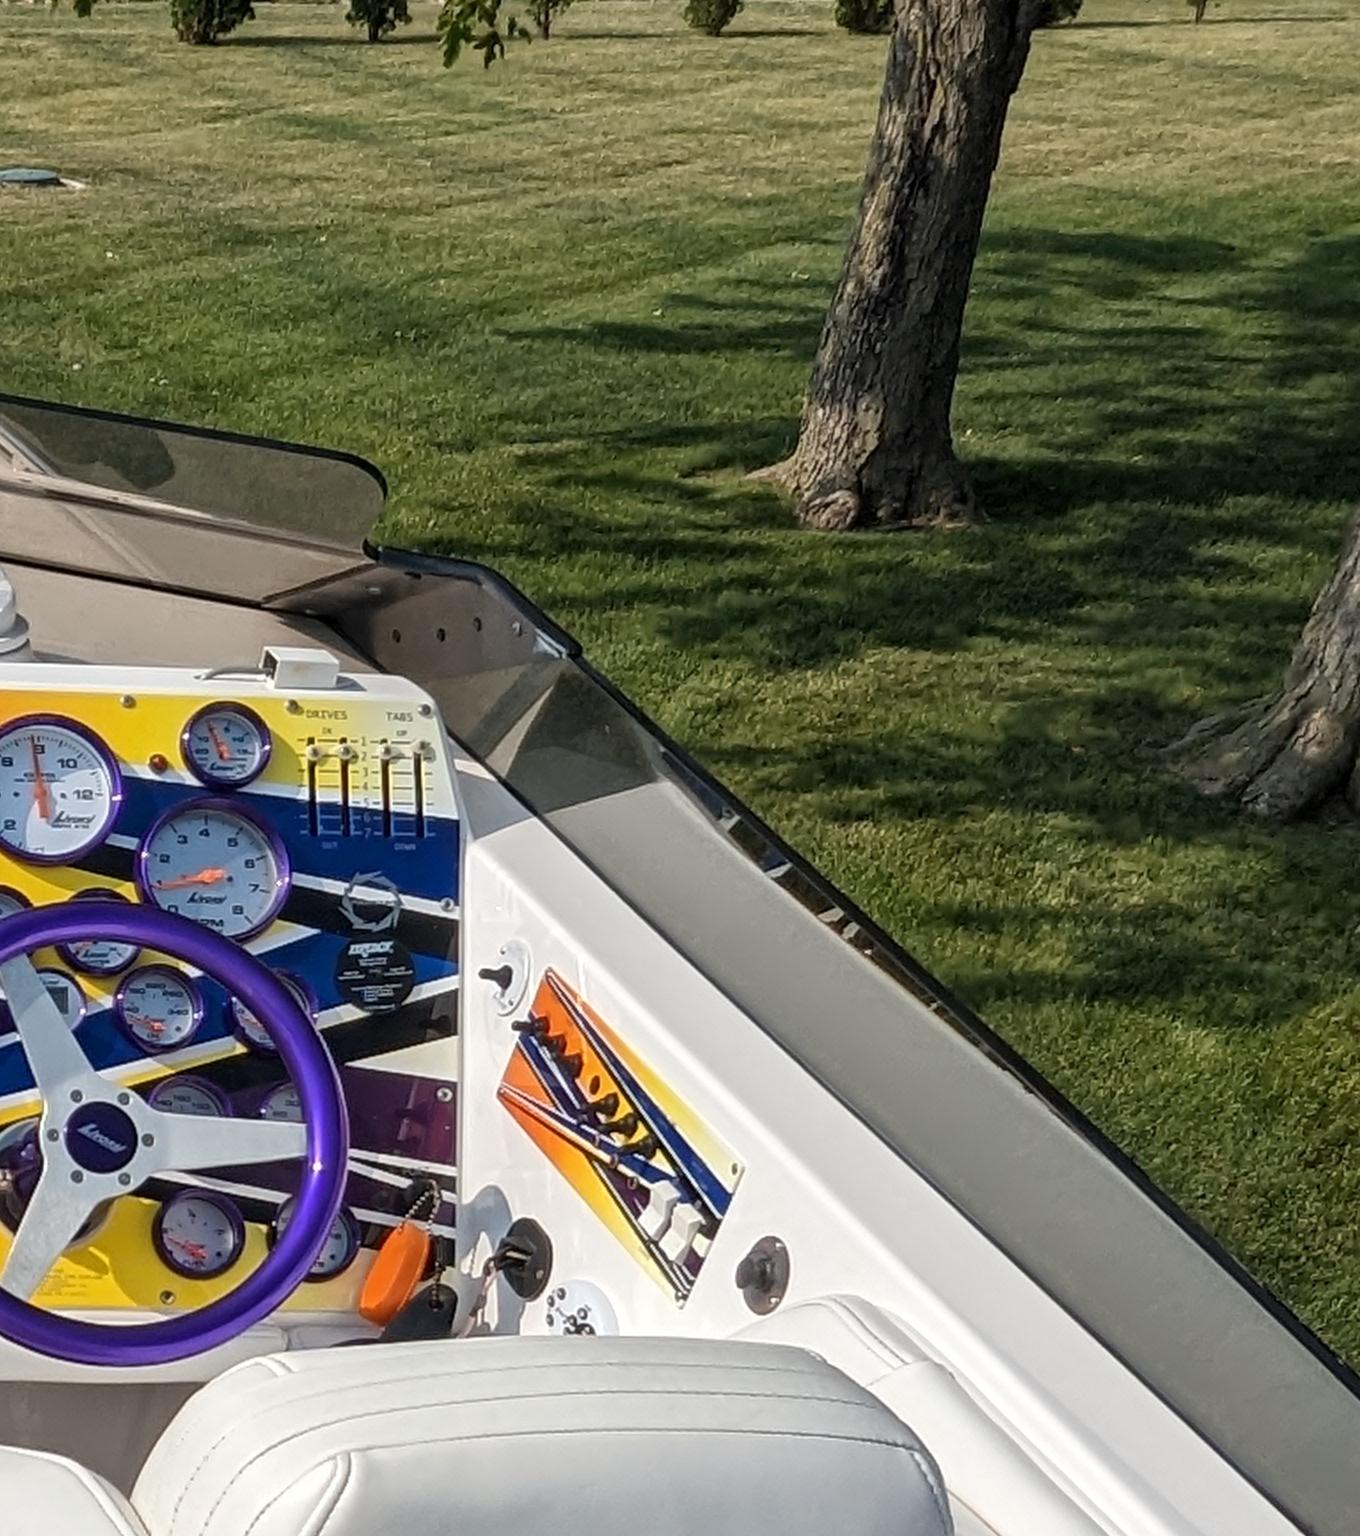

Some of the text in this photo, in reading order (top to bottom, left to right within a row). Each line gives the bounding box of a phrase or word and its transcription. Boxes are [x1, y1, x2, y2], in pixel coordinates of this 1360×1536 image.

[306, 710, 347, 720] DRIVES
[386, 712, 413, 722] TABS
[1, 756, 14, 767] 6
[361, 752, 367, 761] 2
[57, 758, 78, 769] 10
[362, 782, 369, 790] 4
[73, 789, 93, 800] 12
[4, 819, 17, 830] 2
[199, 828, 210, 837] 4
[364, 829, 371, 838] 7
[177, 835, 188, 844] 3
[227, 838, 239, 847] 5
[244, 859, 256, 869] 6
[249, 883, 260, 893] 7
[232, 905, 244, 915] 8
